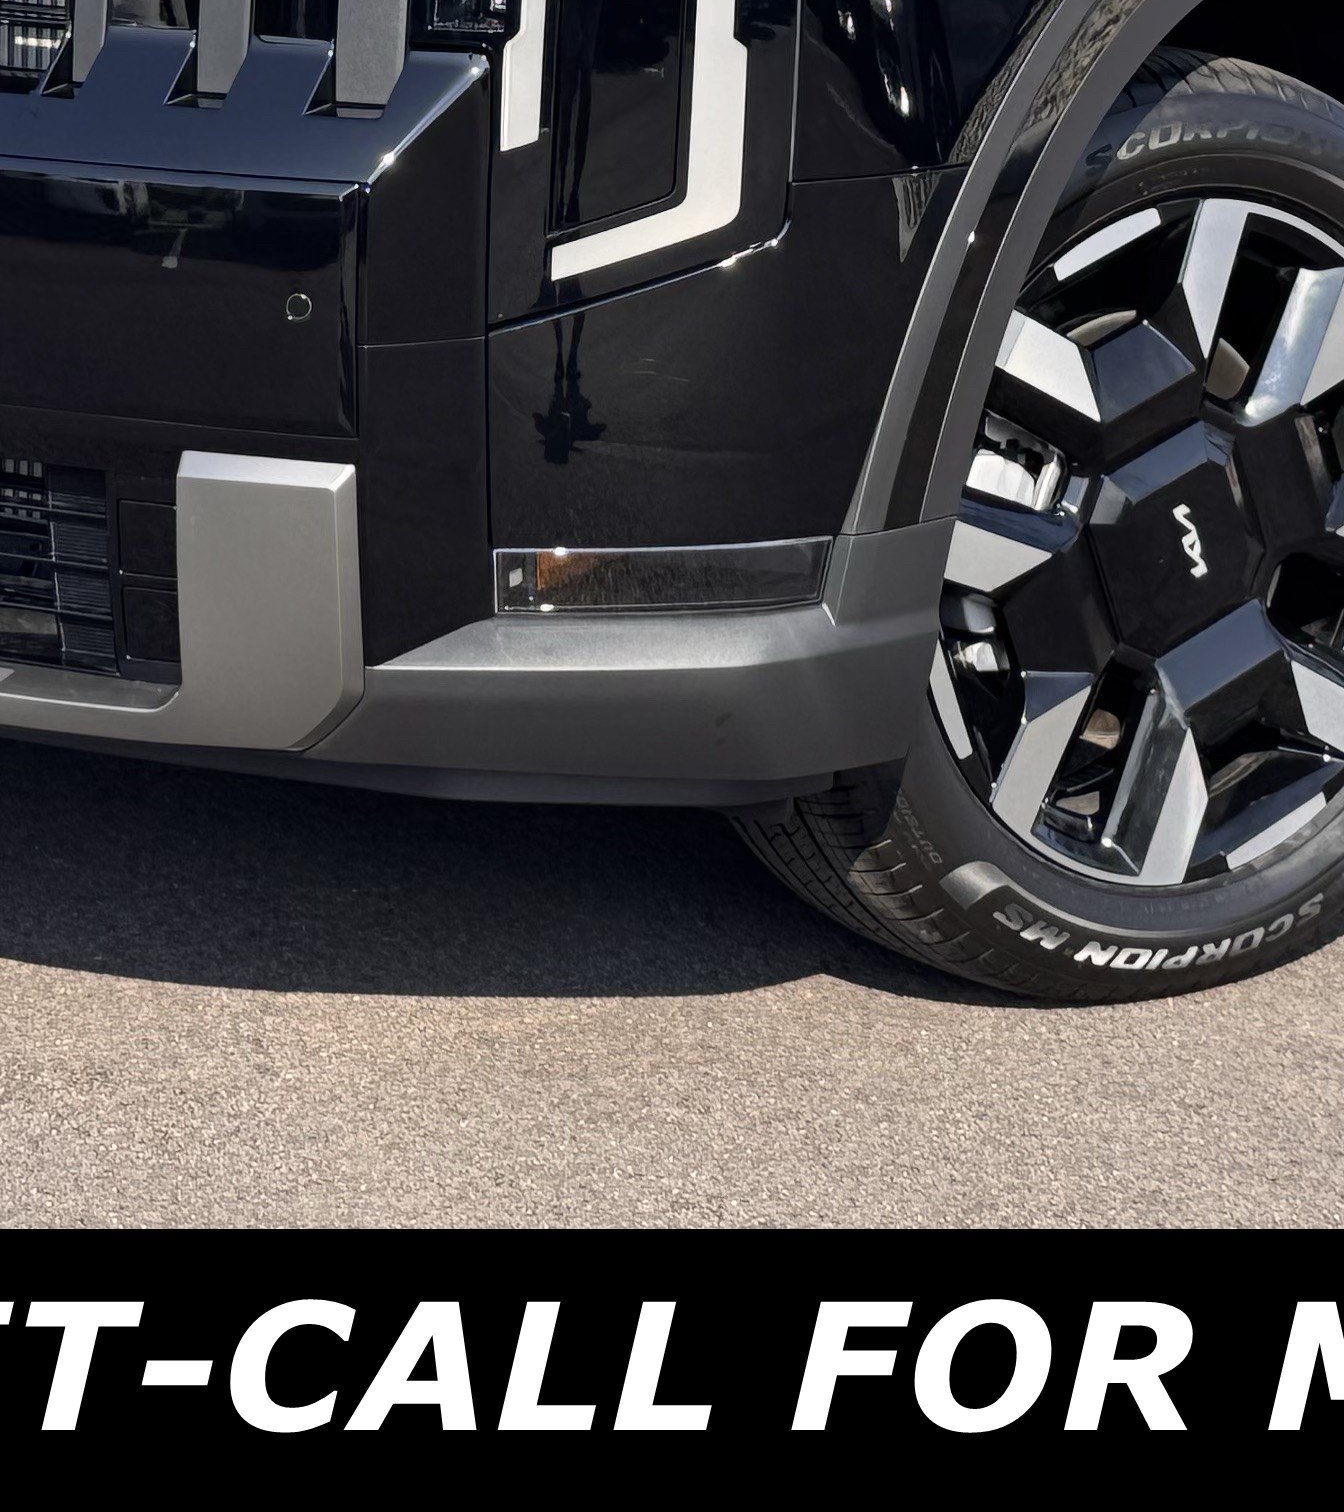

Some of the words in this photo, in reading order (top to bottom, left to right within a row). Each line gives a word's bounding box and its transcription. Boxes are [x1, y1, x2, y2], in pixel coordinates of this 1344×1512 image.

[1171, 502, 1209, 579] KIA
[992, 902, 1071, 951] MS
[1073, 891, 1325, 971] SCORPION
